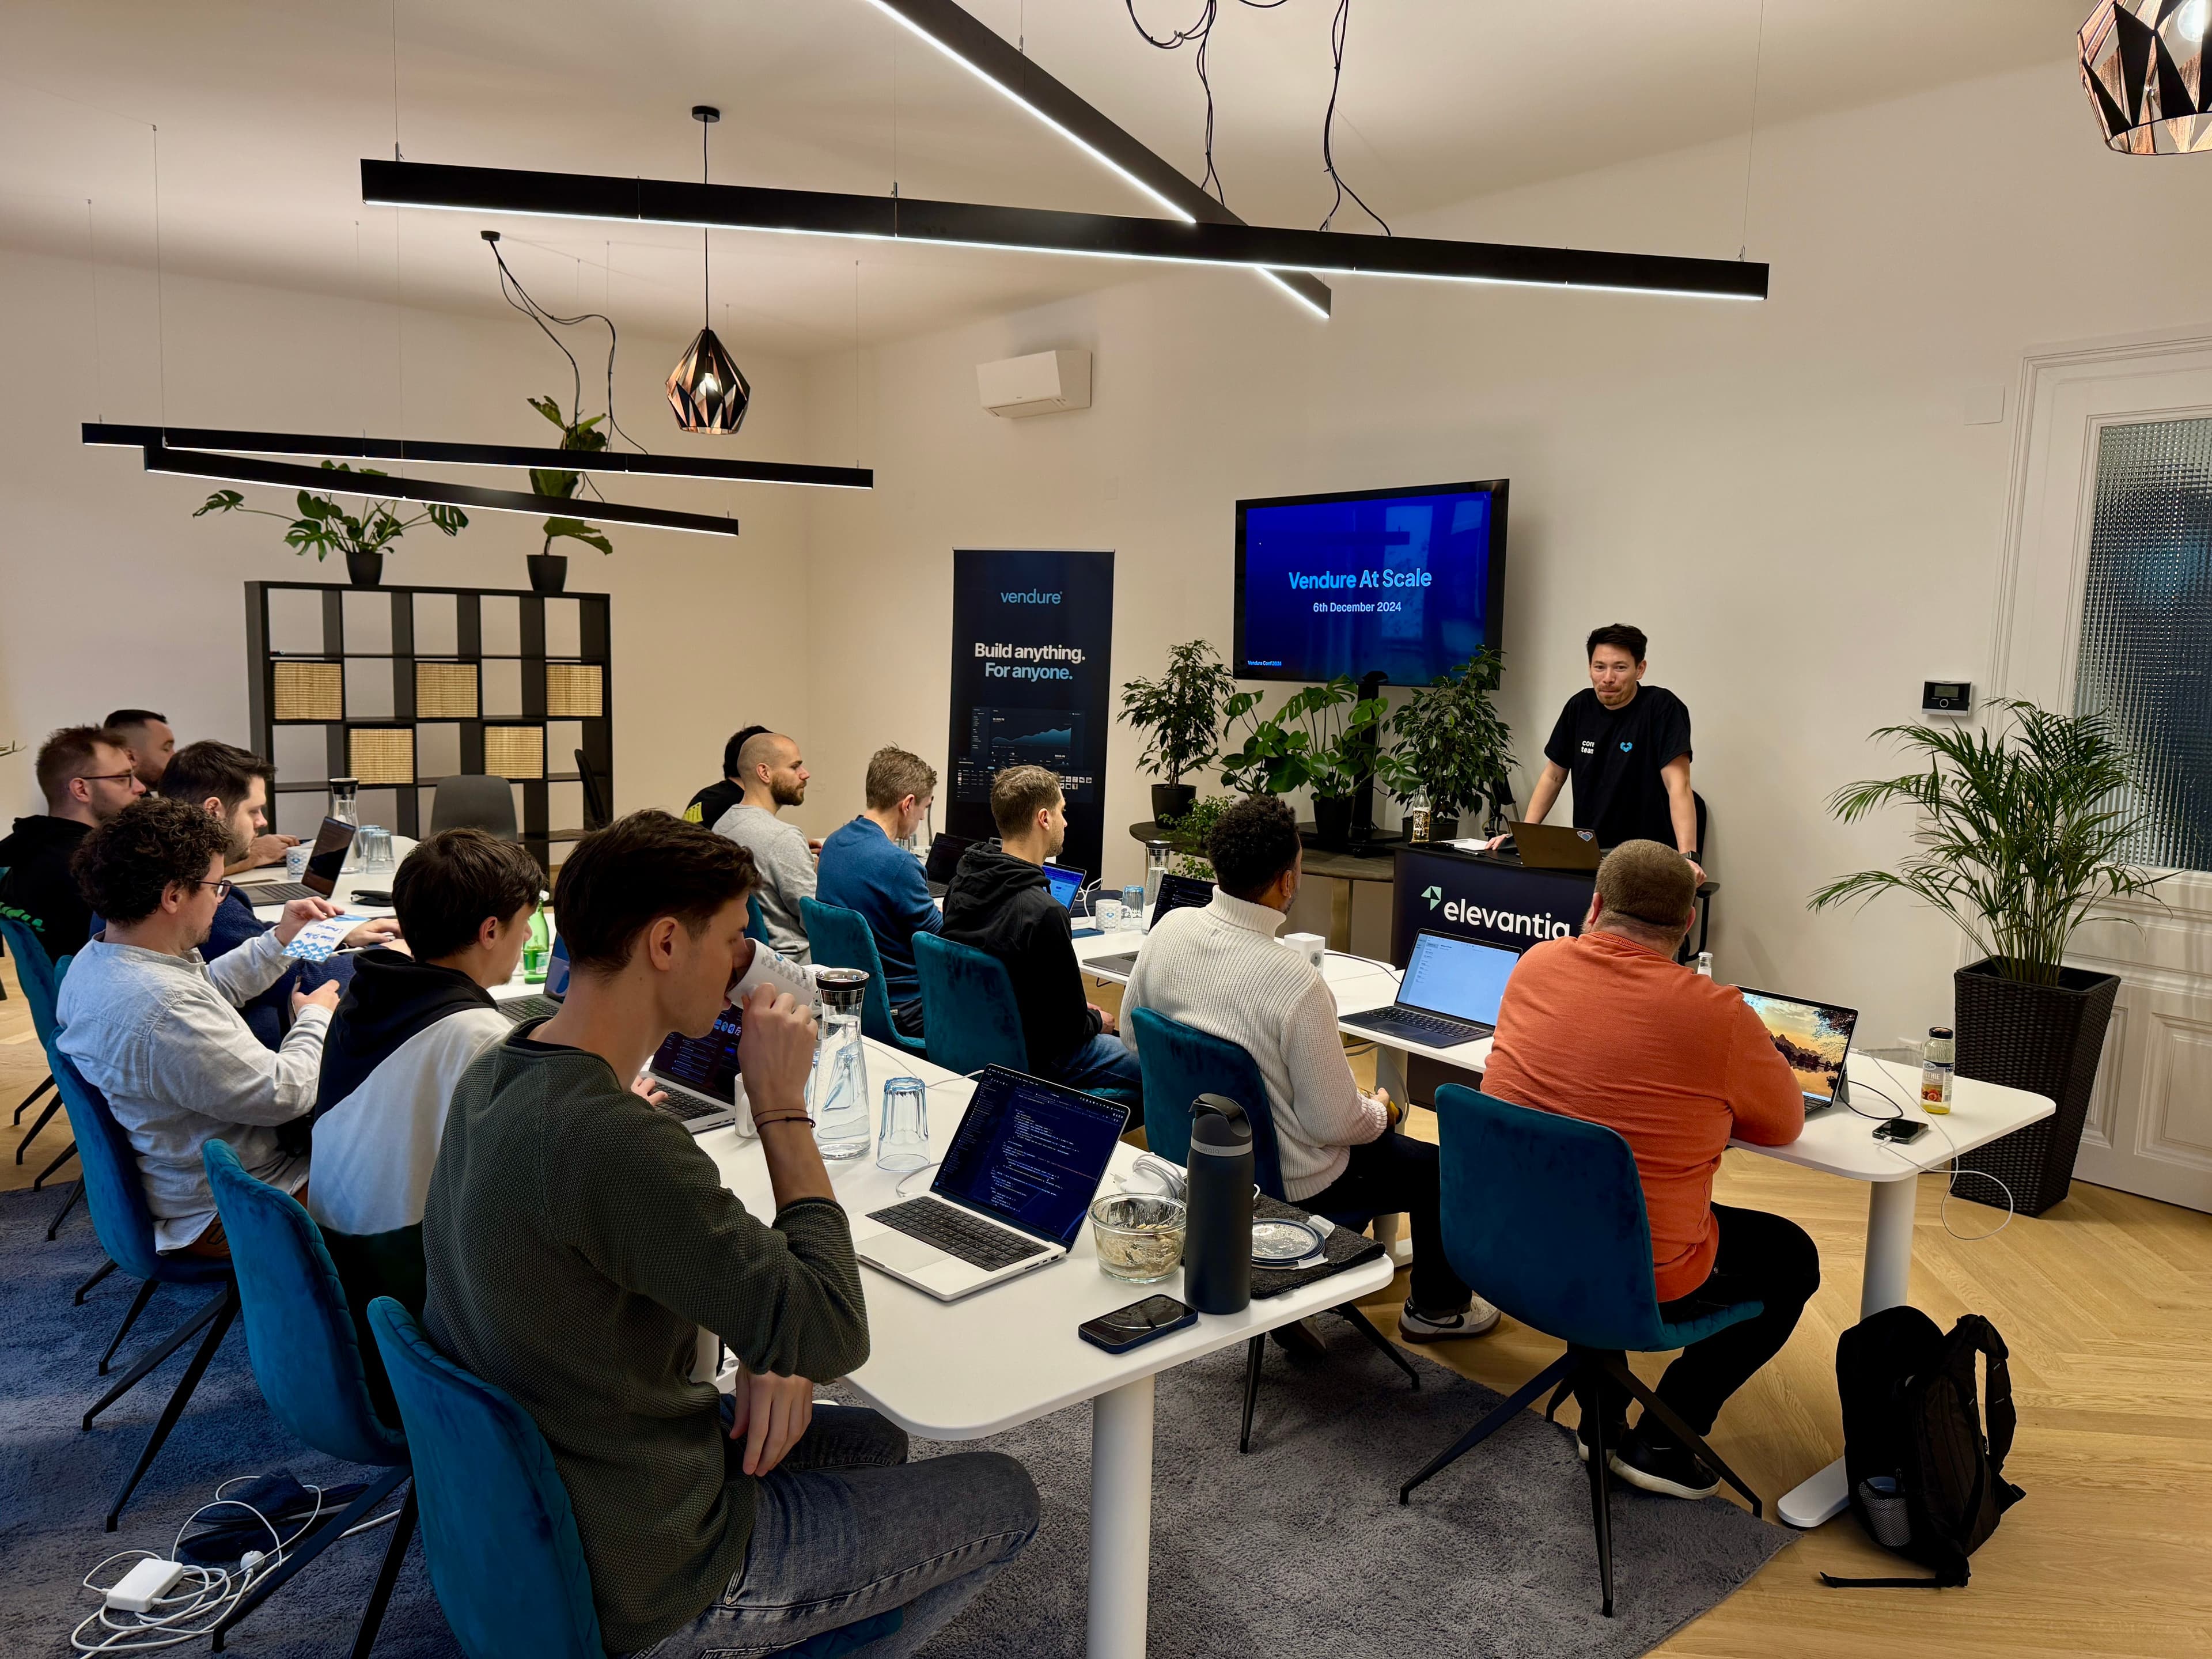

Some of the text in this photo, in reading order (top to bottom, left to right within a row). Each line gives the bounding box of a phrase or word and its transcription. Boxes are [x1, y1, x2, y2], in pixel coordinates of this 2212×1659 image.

[1289, 567, 1432, 589] Vendure At Scale
[1001, 588, 1062, 604] vendure
[1313, 601, 1402, 612] 6th December 2024
[975, 642, 1086, 664] Build anything.
[985, 662, 1073, 682] For anyone.
